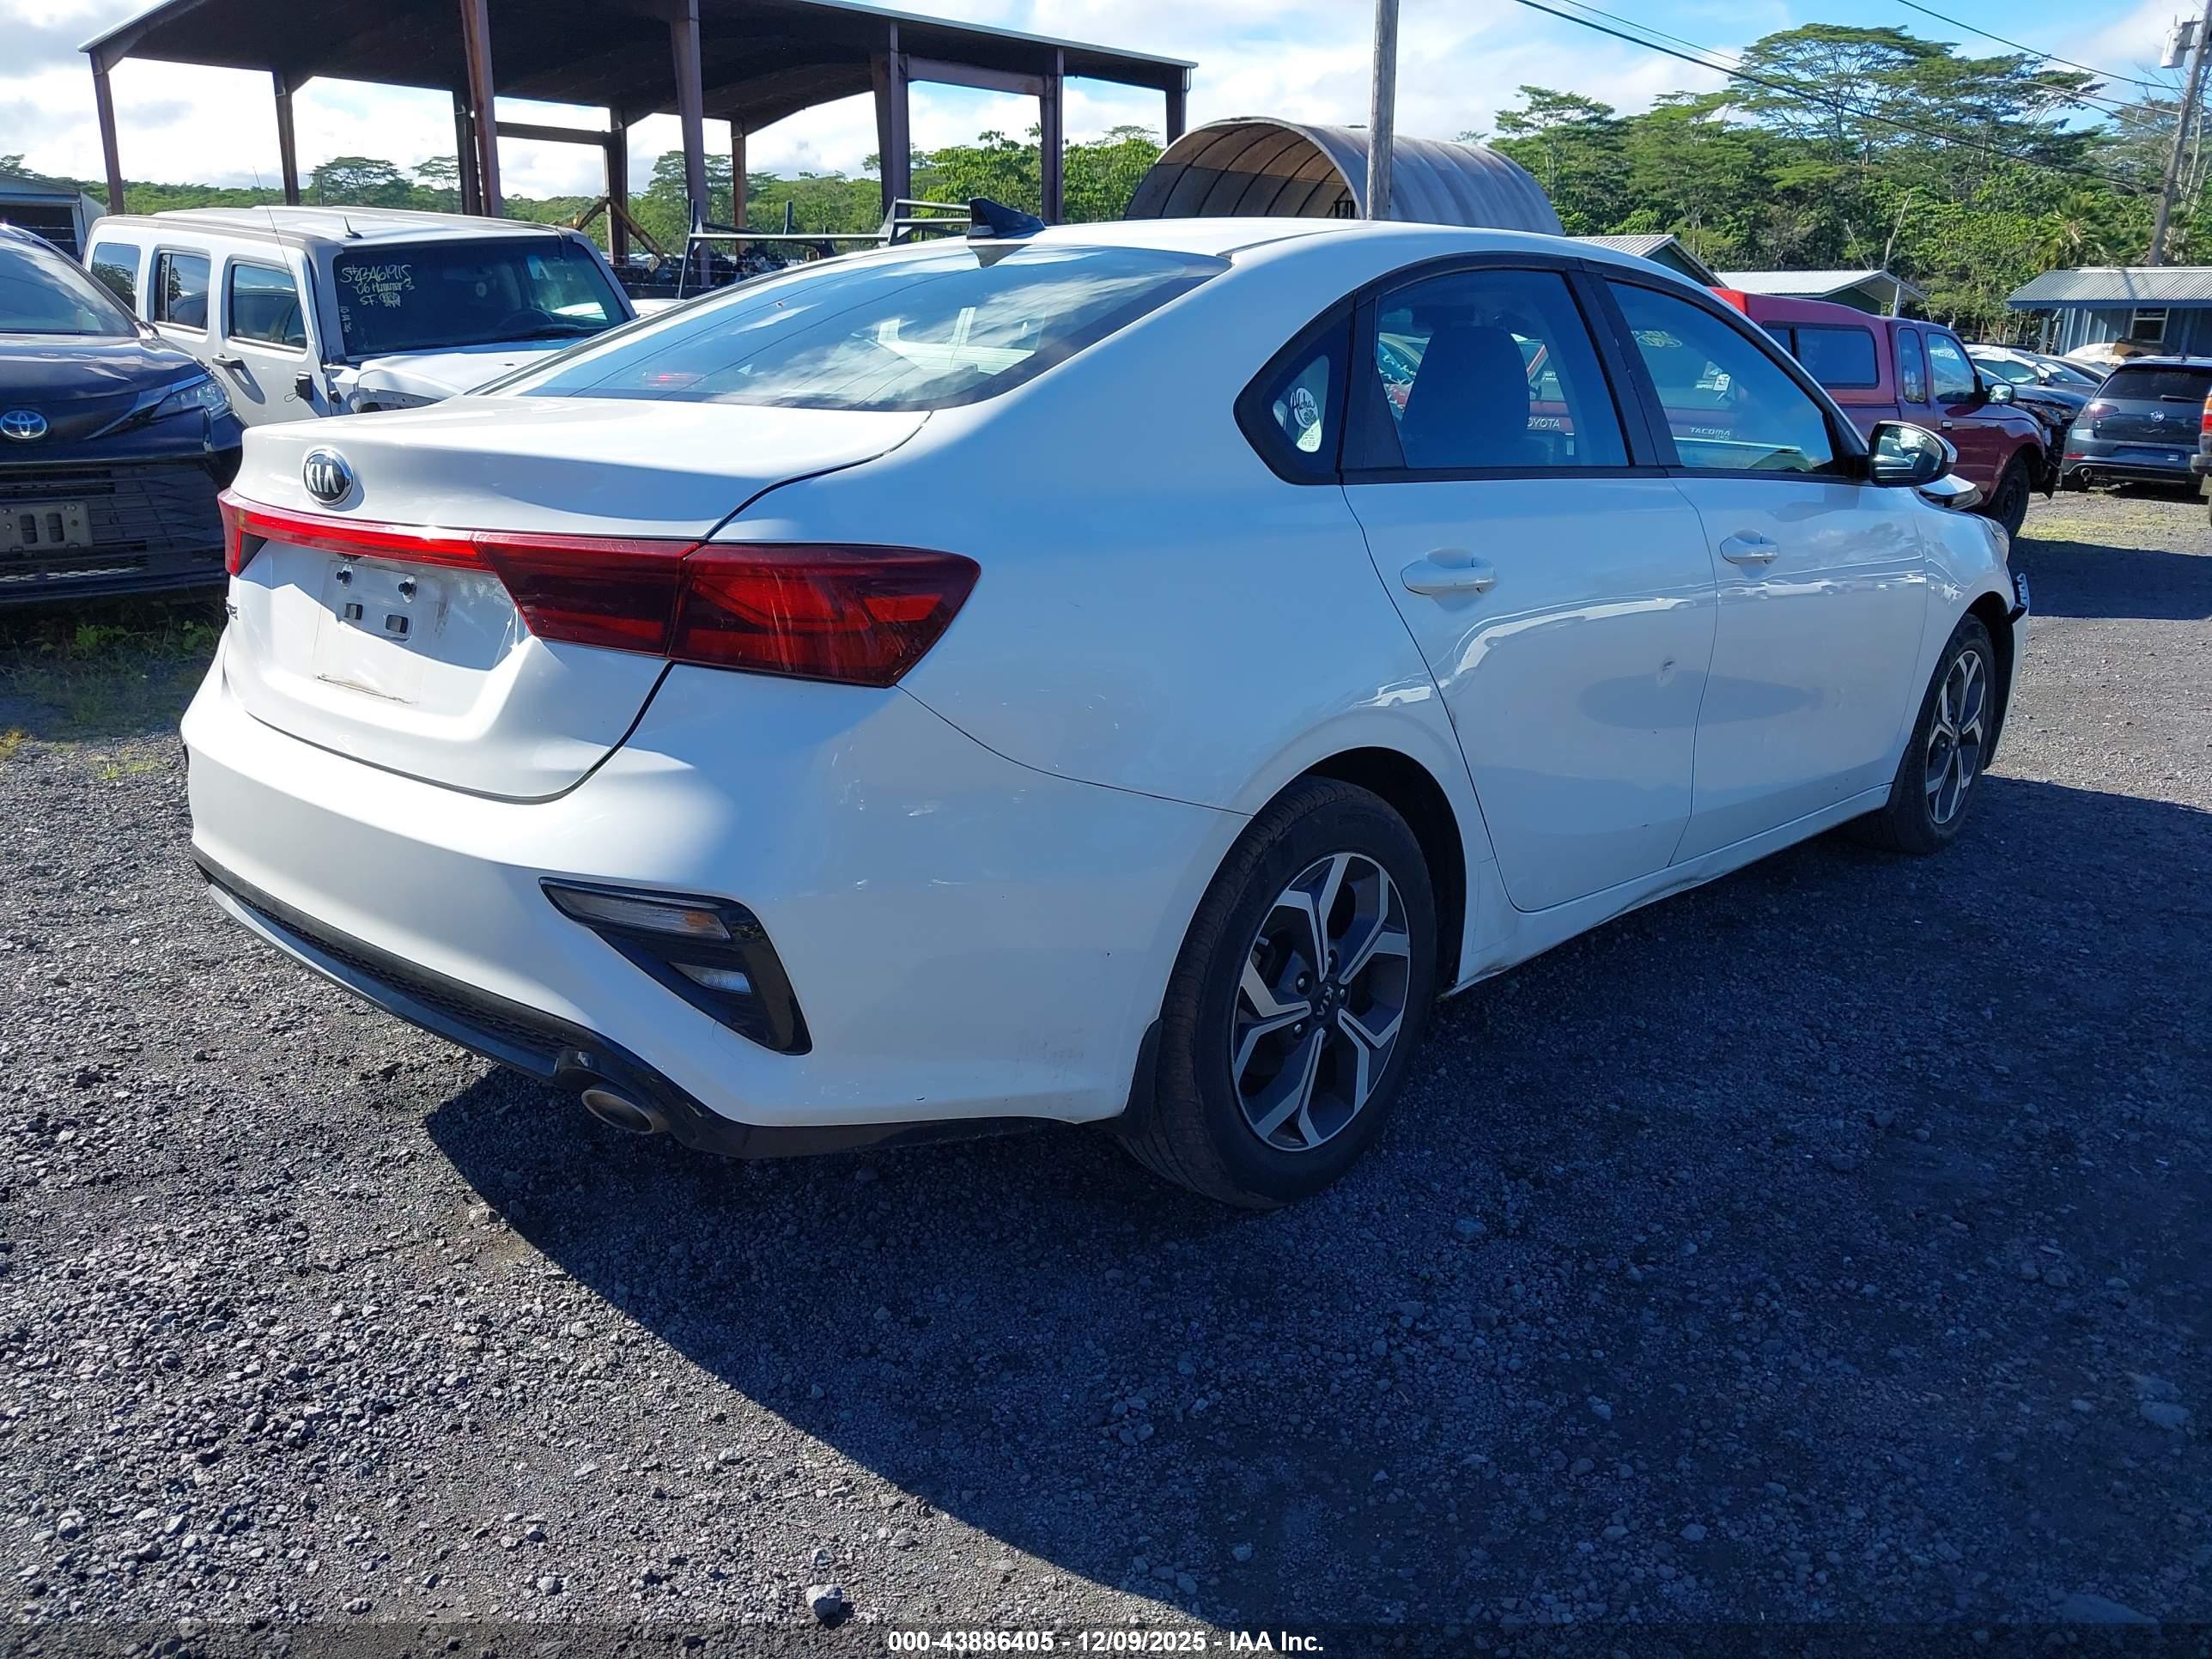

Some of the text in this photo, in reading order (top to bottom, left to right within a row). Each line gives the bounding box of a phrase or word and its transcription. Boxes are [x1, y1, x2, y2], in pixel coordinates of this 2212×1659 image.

[1290, 390, 1316, 410] Aloha
[1528, 416, 1560, 429] OYOTA
[1689, 427, 1731, 436] TACOMA
[306, 463, 340, 494] KIA
[1316, 985, 1334, 1016] KIA
